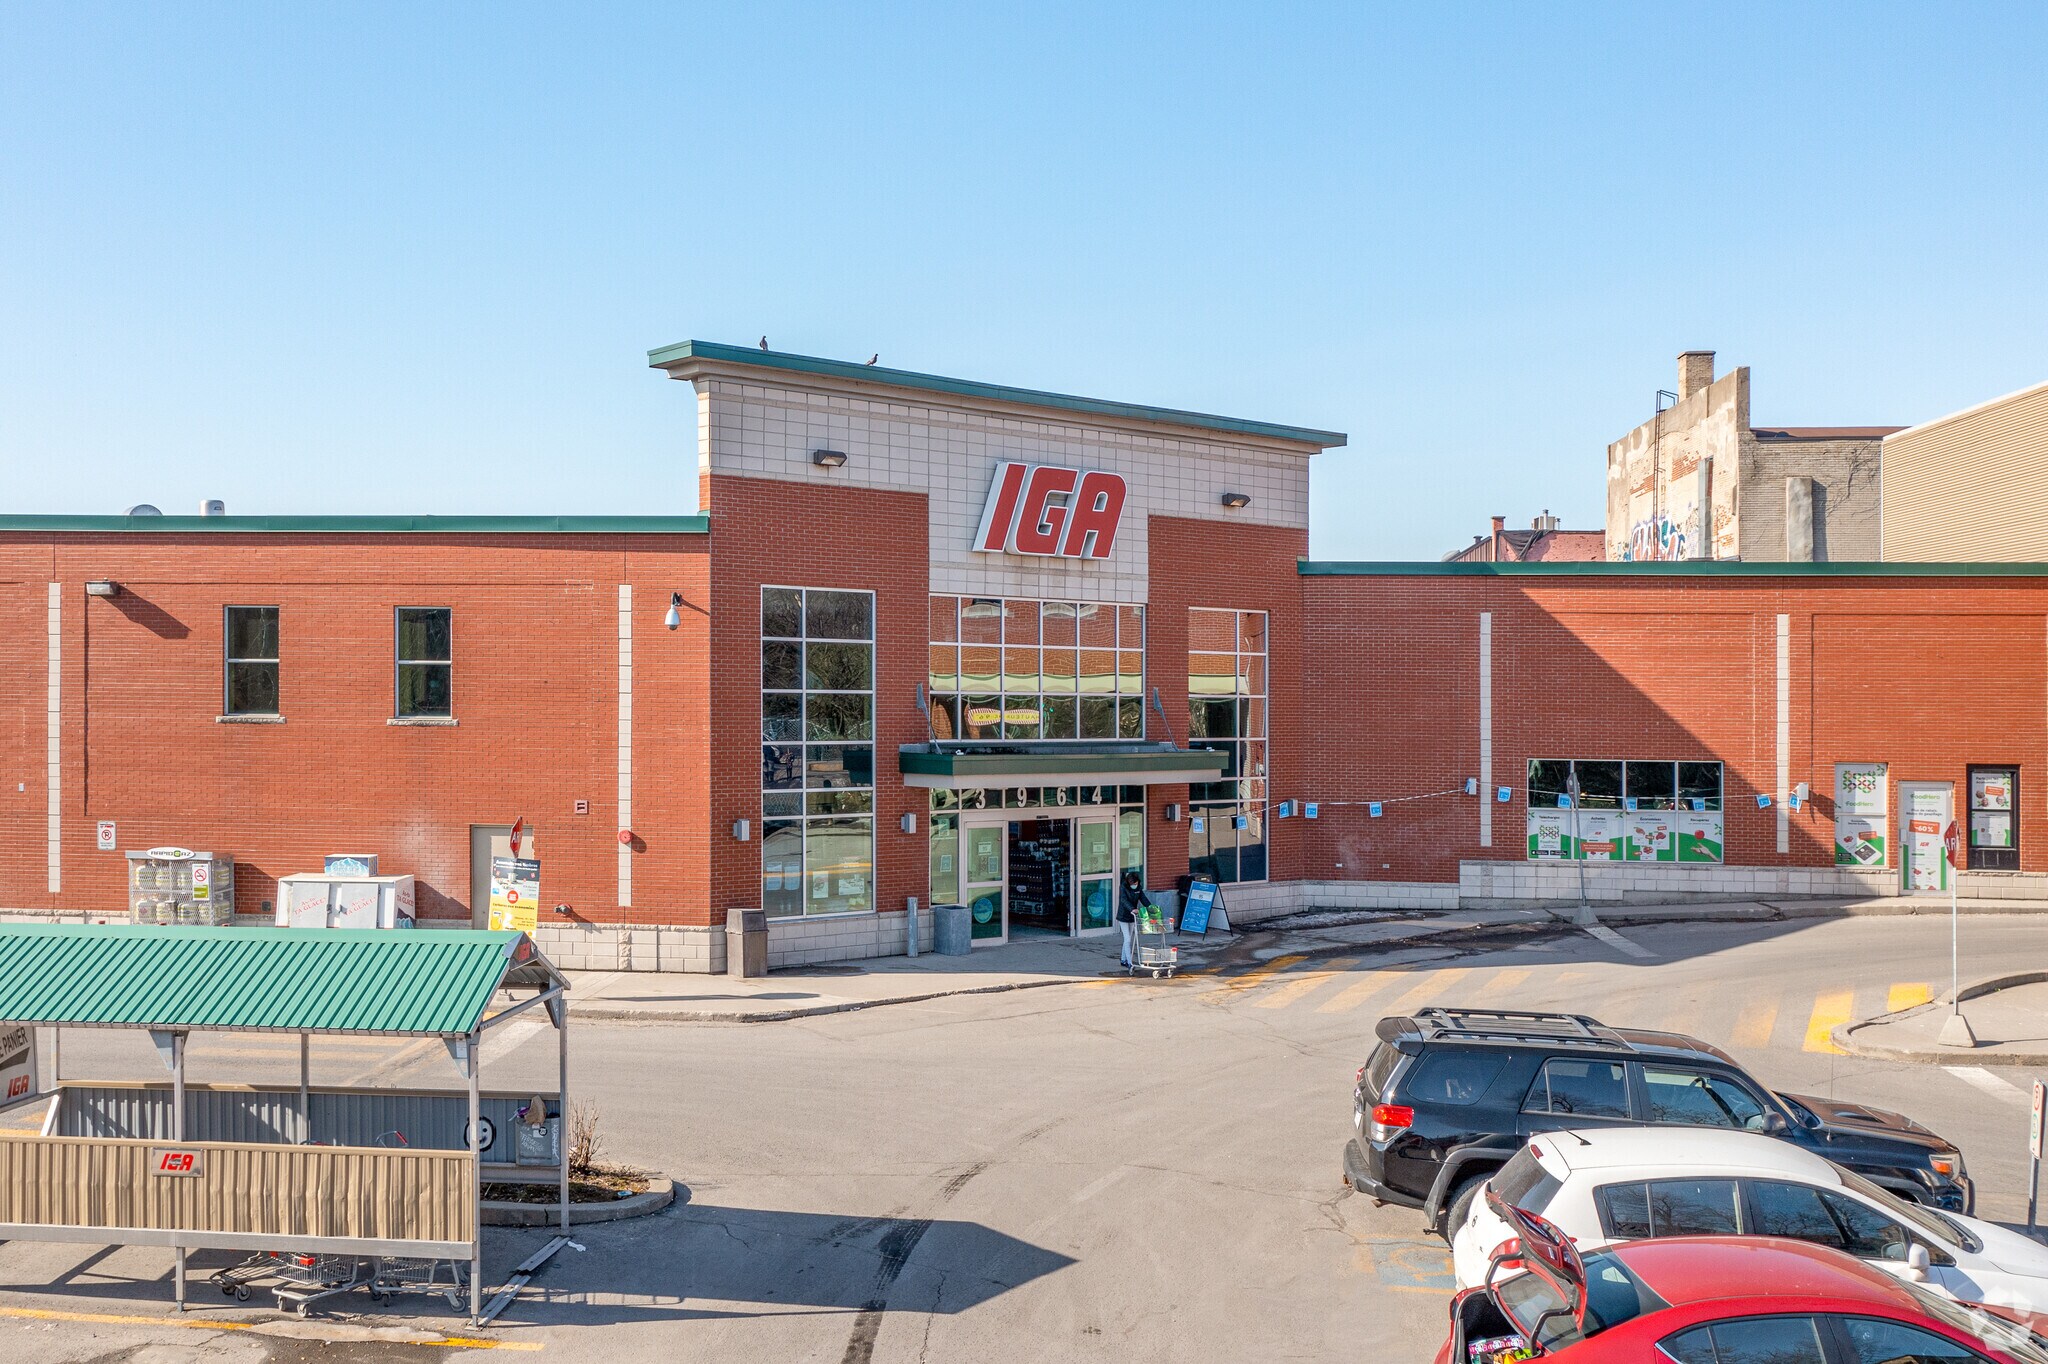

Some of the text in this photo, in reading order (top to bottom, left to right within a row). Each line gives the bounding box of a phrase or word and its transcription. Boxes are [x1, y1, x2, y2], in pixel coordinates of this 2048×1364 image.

[980, 461, 1128, 560] IGA
[2, 1026, 28, 1054] PANIER
[7, 1074, 30, 1099] IGA
[160, 1153, 194, 1171] IGA
